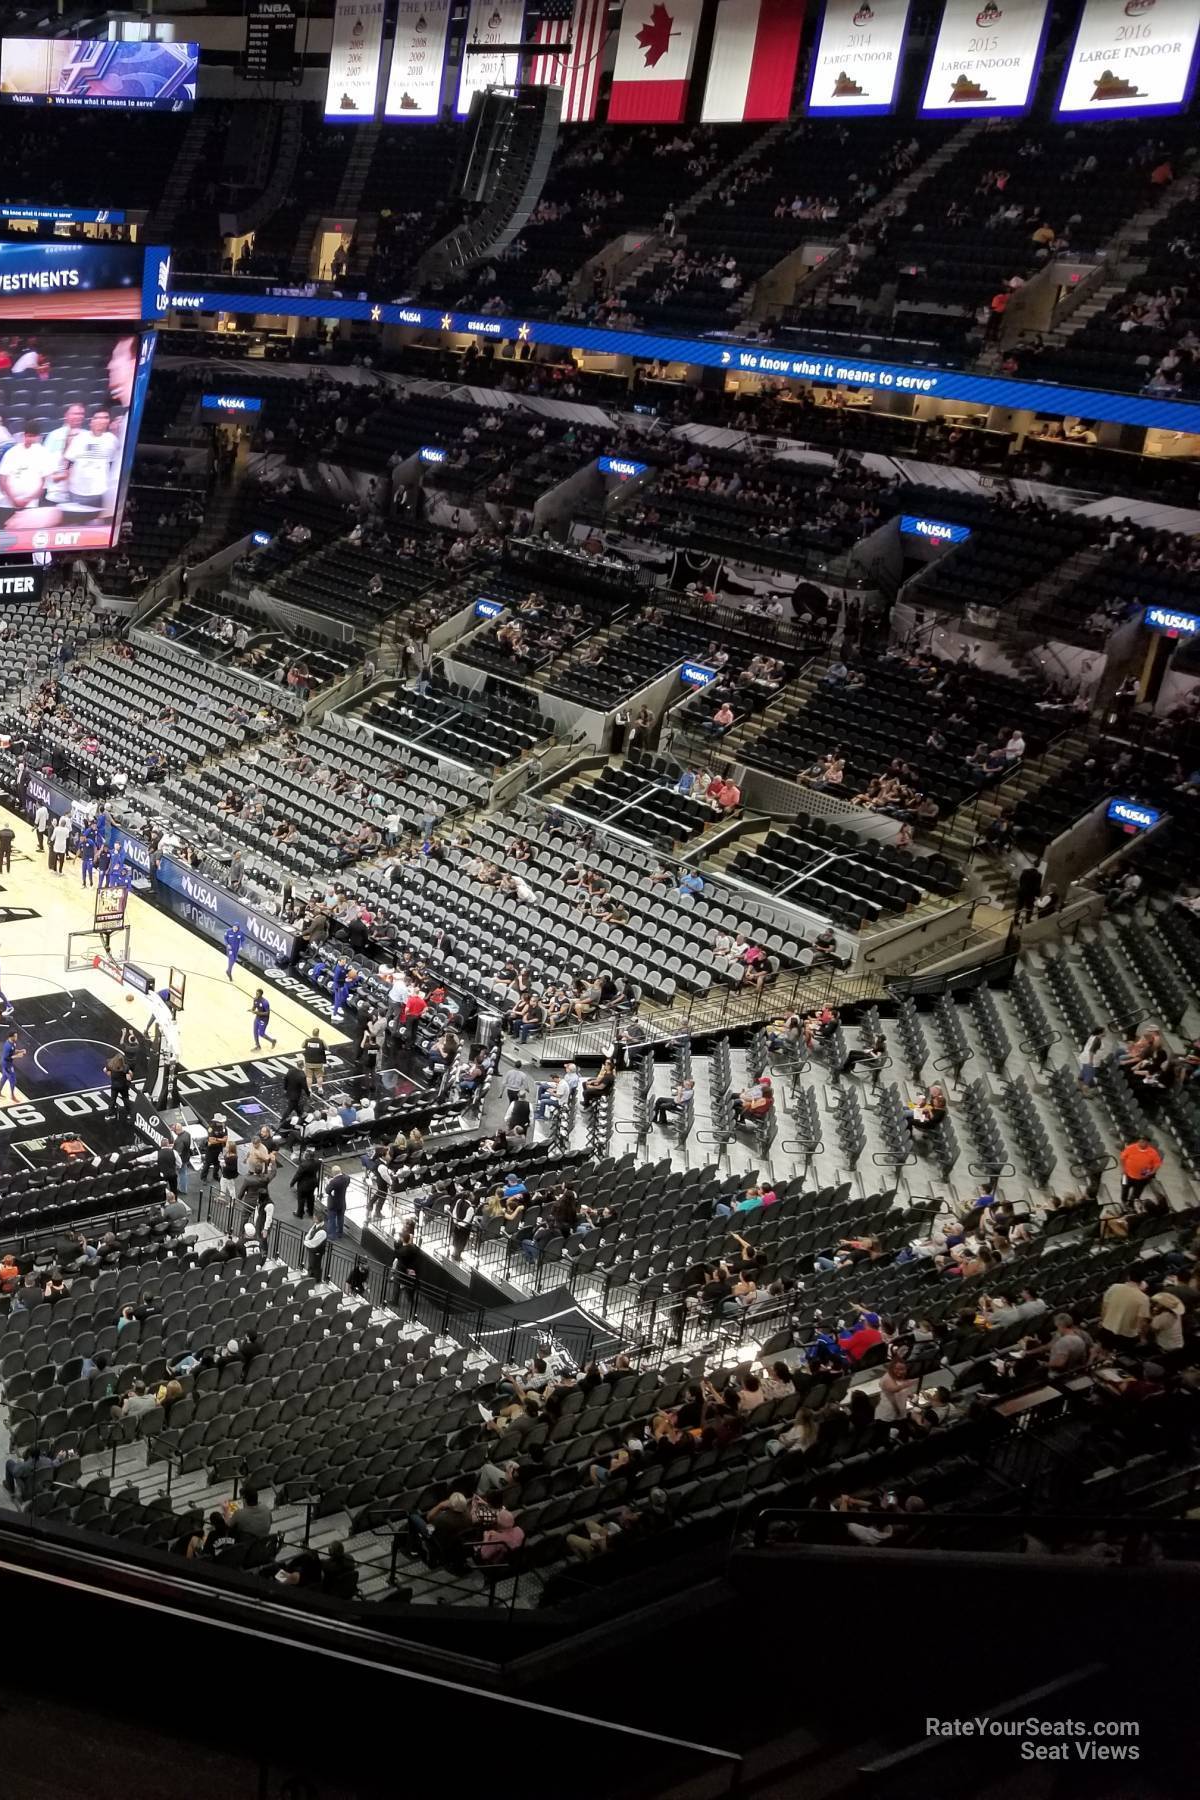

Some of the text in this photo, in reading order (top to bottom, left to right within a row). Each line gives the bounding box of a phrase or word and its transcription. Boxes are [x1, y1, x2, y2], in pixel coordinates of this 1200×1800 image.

[1115, 25, 1152, 42] 2016
[848, 34, 871, 48] 2014
[968, 37, 998, 53] 2015
[853, 51, 893, 62] INDOOR
[1078, 42, 1182, 63] LARGE INDOOR
[942, 57, 1020, 71] LARGE INDOOR
[407, 312, 421, 323] USAA
[468, 321, 500, 333] usaa.com
[740, 353, 757, 367] We
[759, 355, 789, 372] know
[793, 360, 821, 376] what
[824, 363, 833, 377] it
[836, 367, 875, 383] means
[879, 371, 893, 386] to
[227, 399, 245, 408] USAA
[618, 463, 634, 474] USAA
[54, 532, 80, 545] DET
[928, 525, 951, 538] USAA
[1165, 614, 1195, 631] USAA
[193, 885, 217, 912] USAA
[260, 928, 287, 954] USAA
